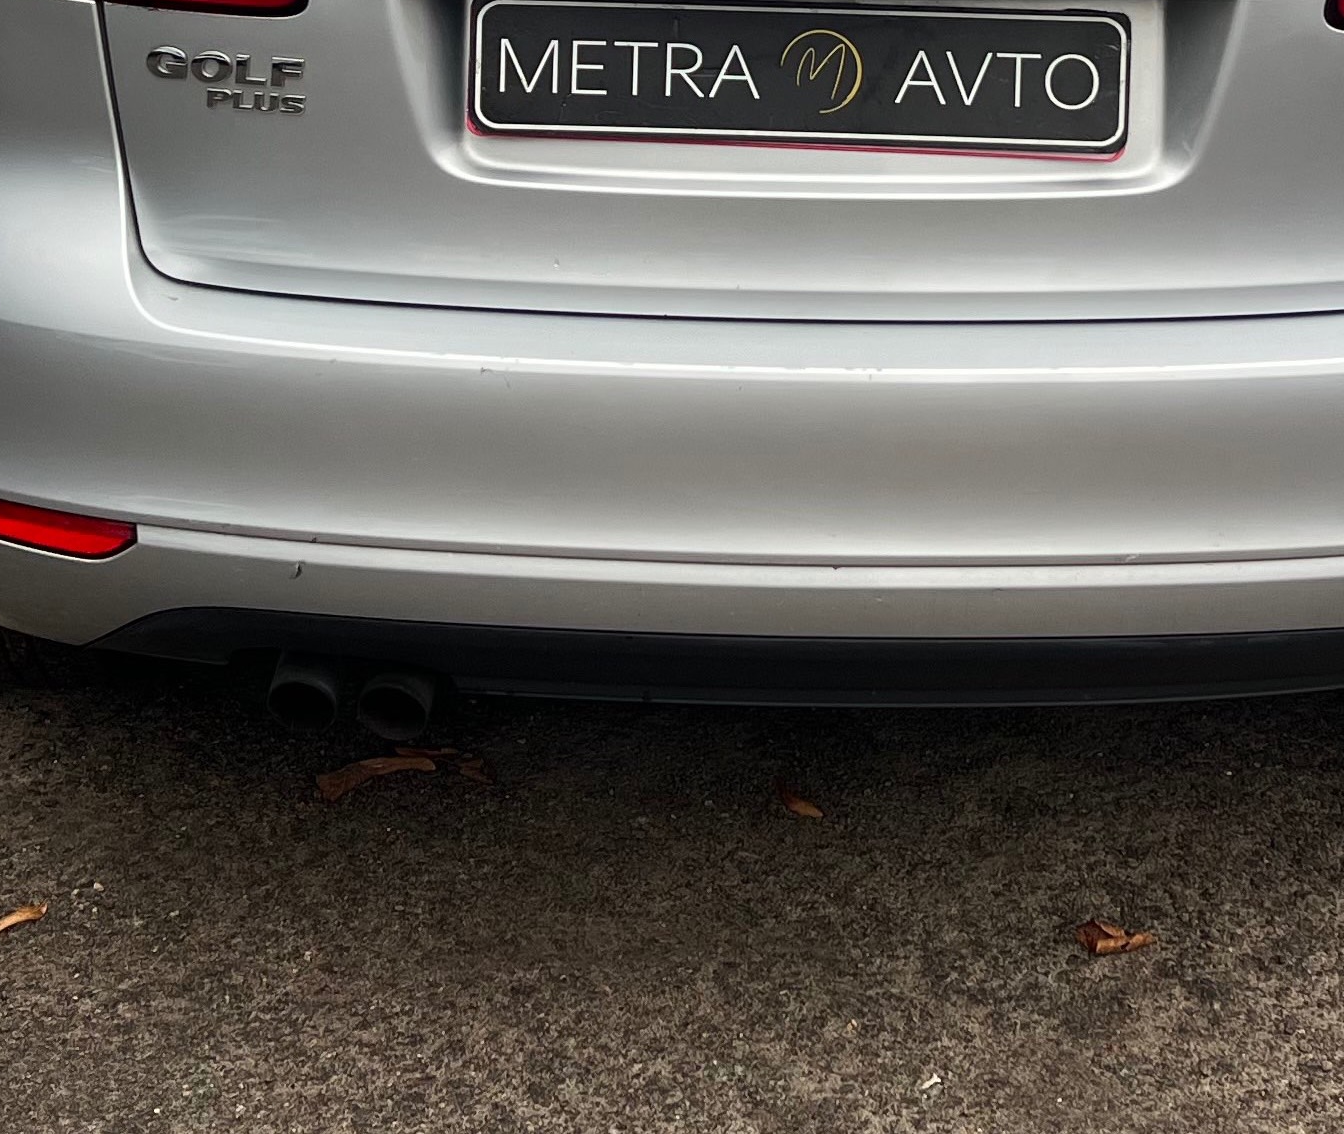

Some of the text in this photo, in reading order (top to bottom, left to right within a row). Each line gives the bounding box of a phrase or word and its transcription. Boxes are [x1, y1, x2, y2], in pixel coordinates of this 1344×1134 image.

[145, 44, 306, 87] GOLF
[498, 37, 760, 100] METRA
[894, 50, 1101, 111] AVTO
[206, 86, 307, 115] PLUS
